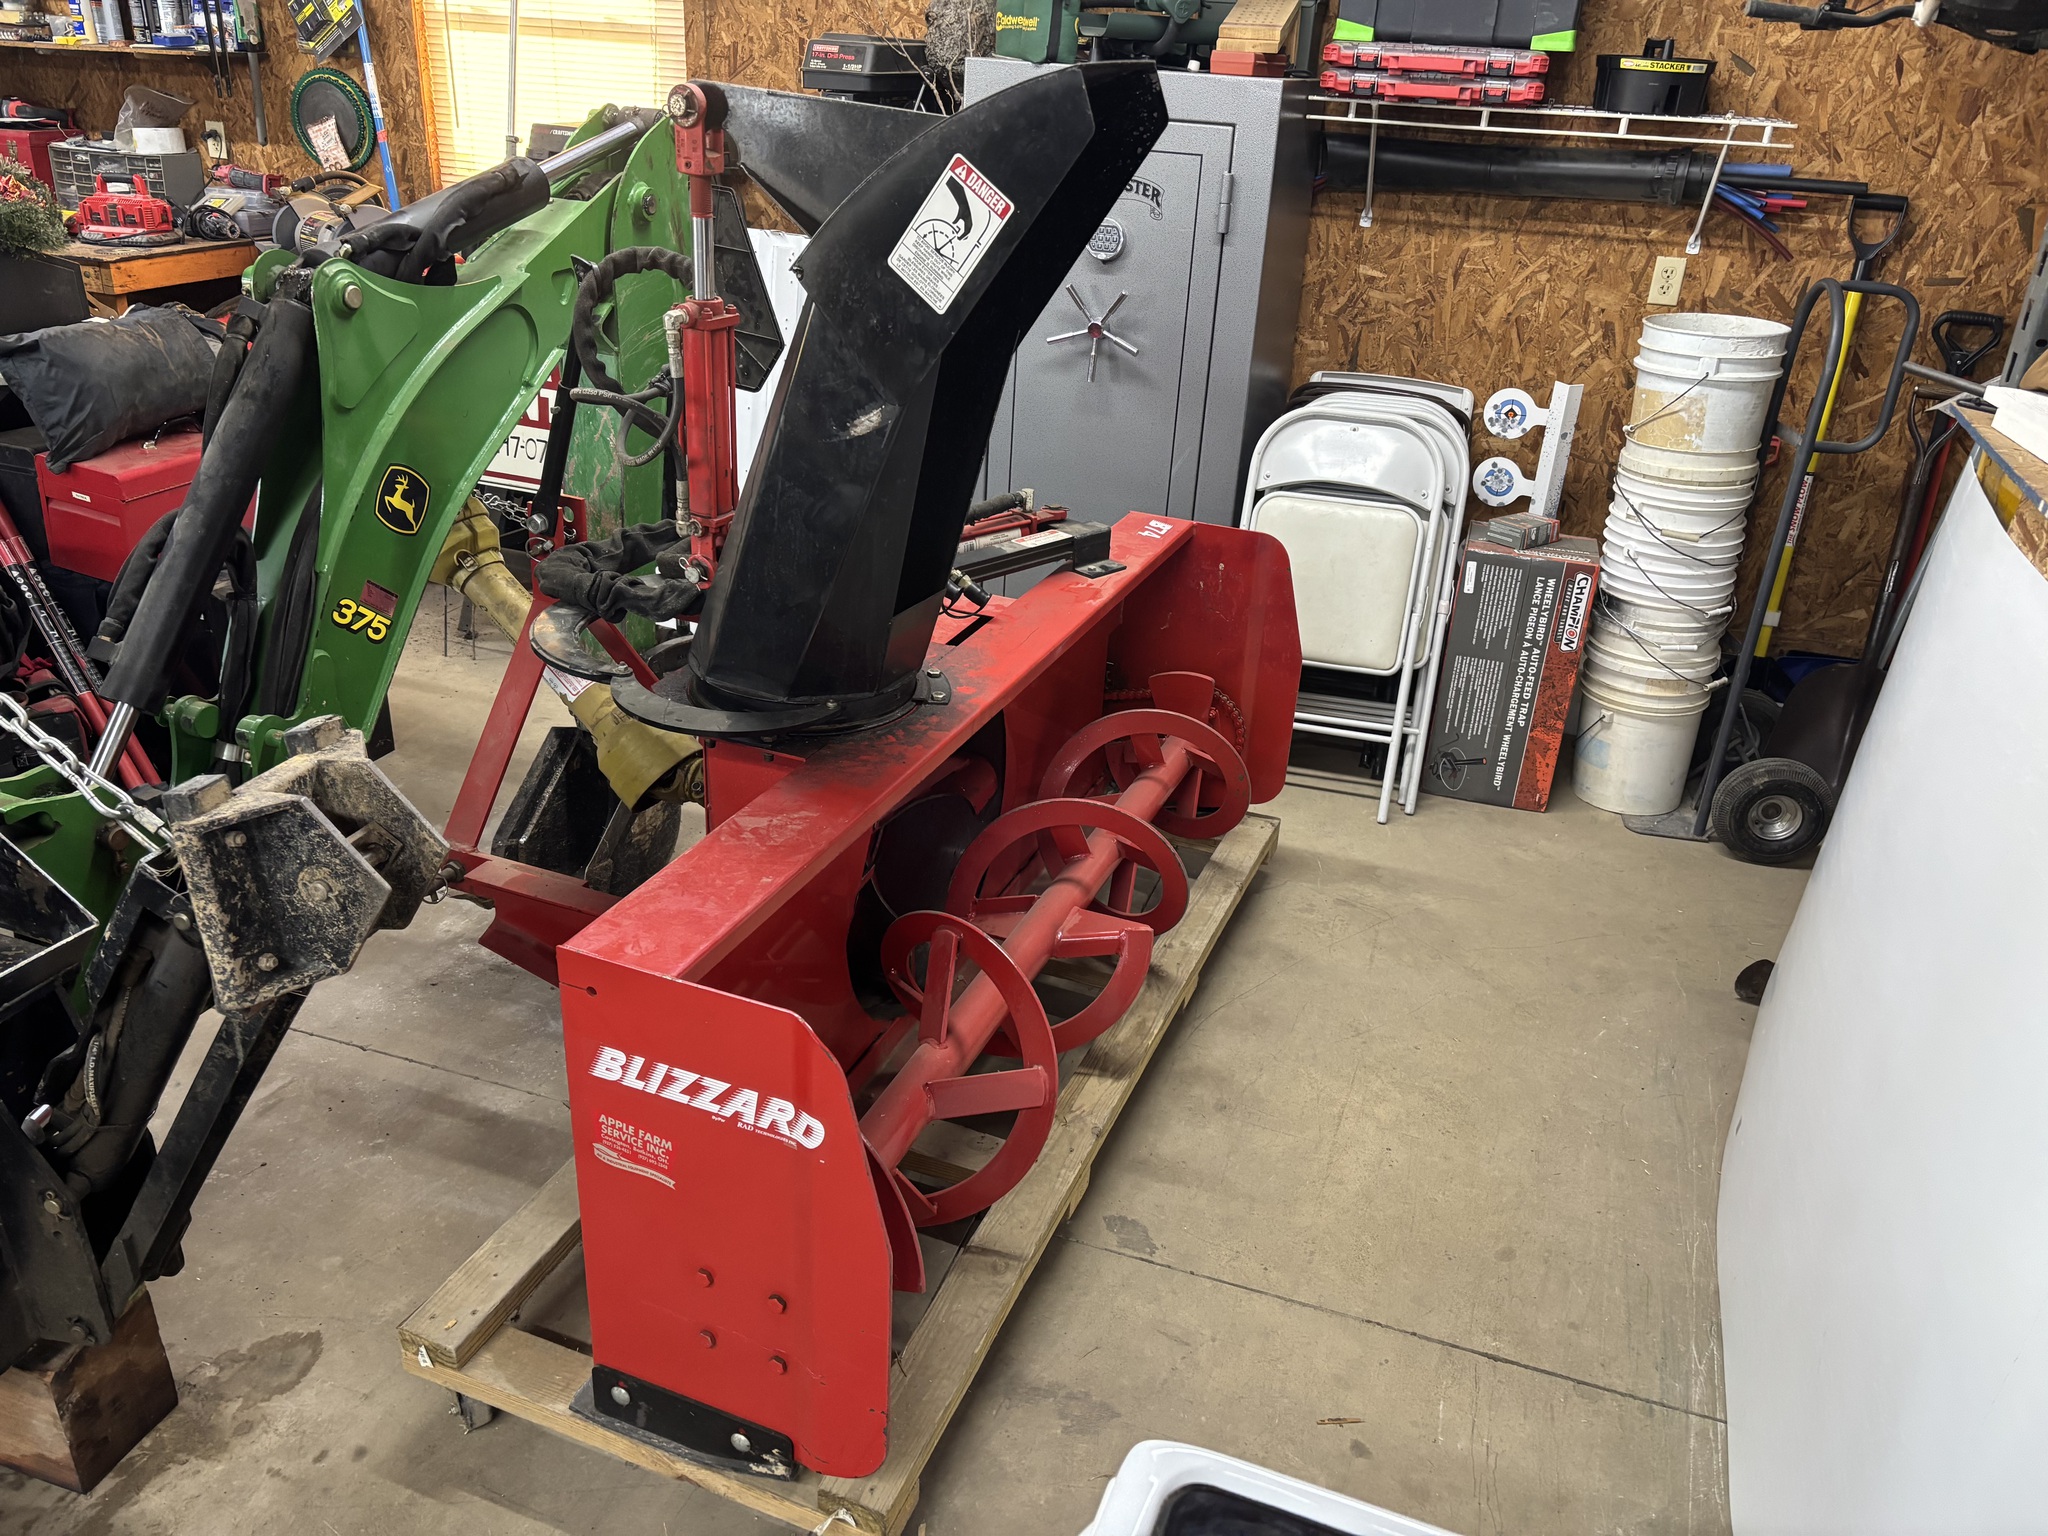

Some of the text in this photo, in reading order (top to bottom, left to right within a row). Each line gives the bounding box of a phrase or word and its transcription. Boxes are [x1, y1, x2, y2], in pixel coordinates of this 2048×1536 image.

[1650, 62, 1685, 71] STACKER
[965, 171, 1007, 215] DANGER
[1789, 507, 1800, 532] SNOW
[1797, 480, 1809, 504] PLOW
[1532, 577, 1546, 606] LANCE
[1565, 583, 1574, 603] RANGE
[332, 598, 392, 641] 375
[1524, 607, 1539, 639] PIGEON
[1556, 620, 1565, 639] TARGET
[1563, 576, 1589, 651] CHAMPION
[1504, 650, 1529, 732] AUTO-CHARGEMENT
[1523, 648, 1541, 700] AUTO-FEED
[1517, 702, 1530, 727] TRAP
[588, 1045, 825, 1150] BLIZZARD
[599, 1114, 673, 1151] APPLE FARM
[601, 1124, 670, 1160] SERVICE INC.
[737, 1121, 754, 1132] RAD
